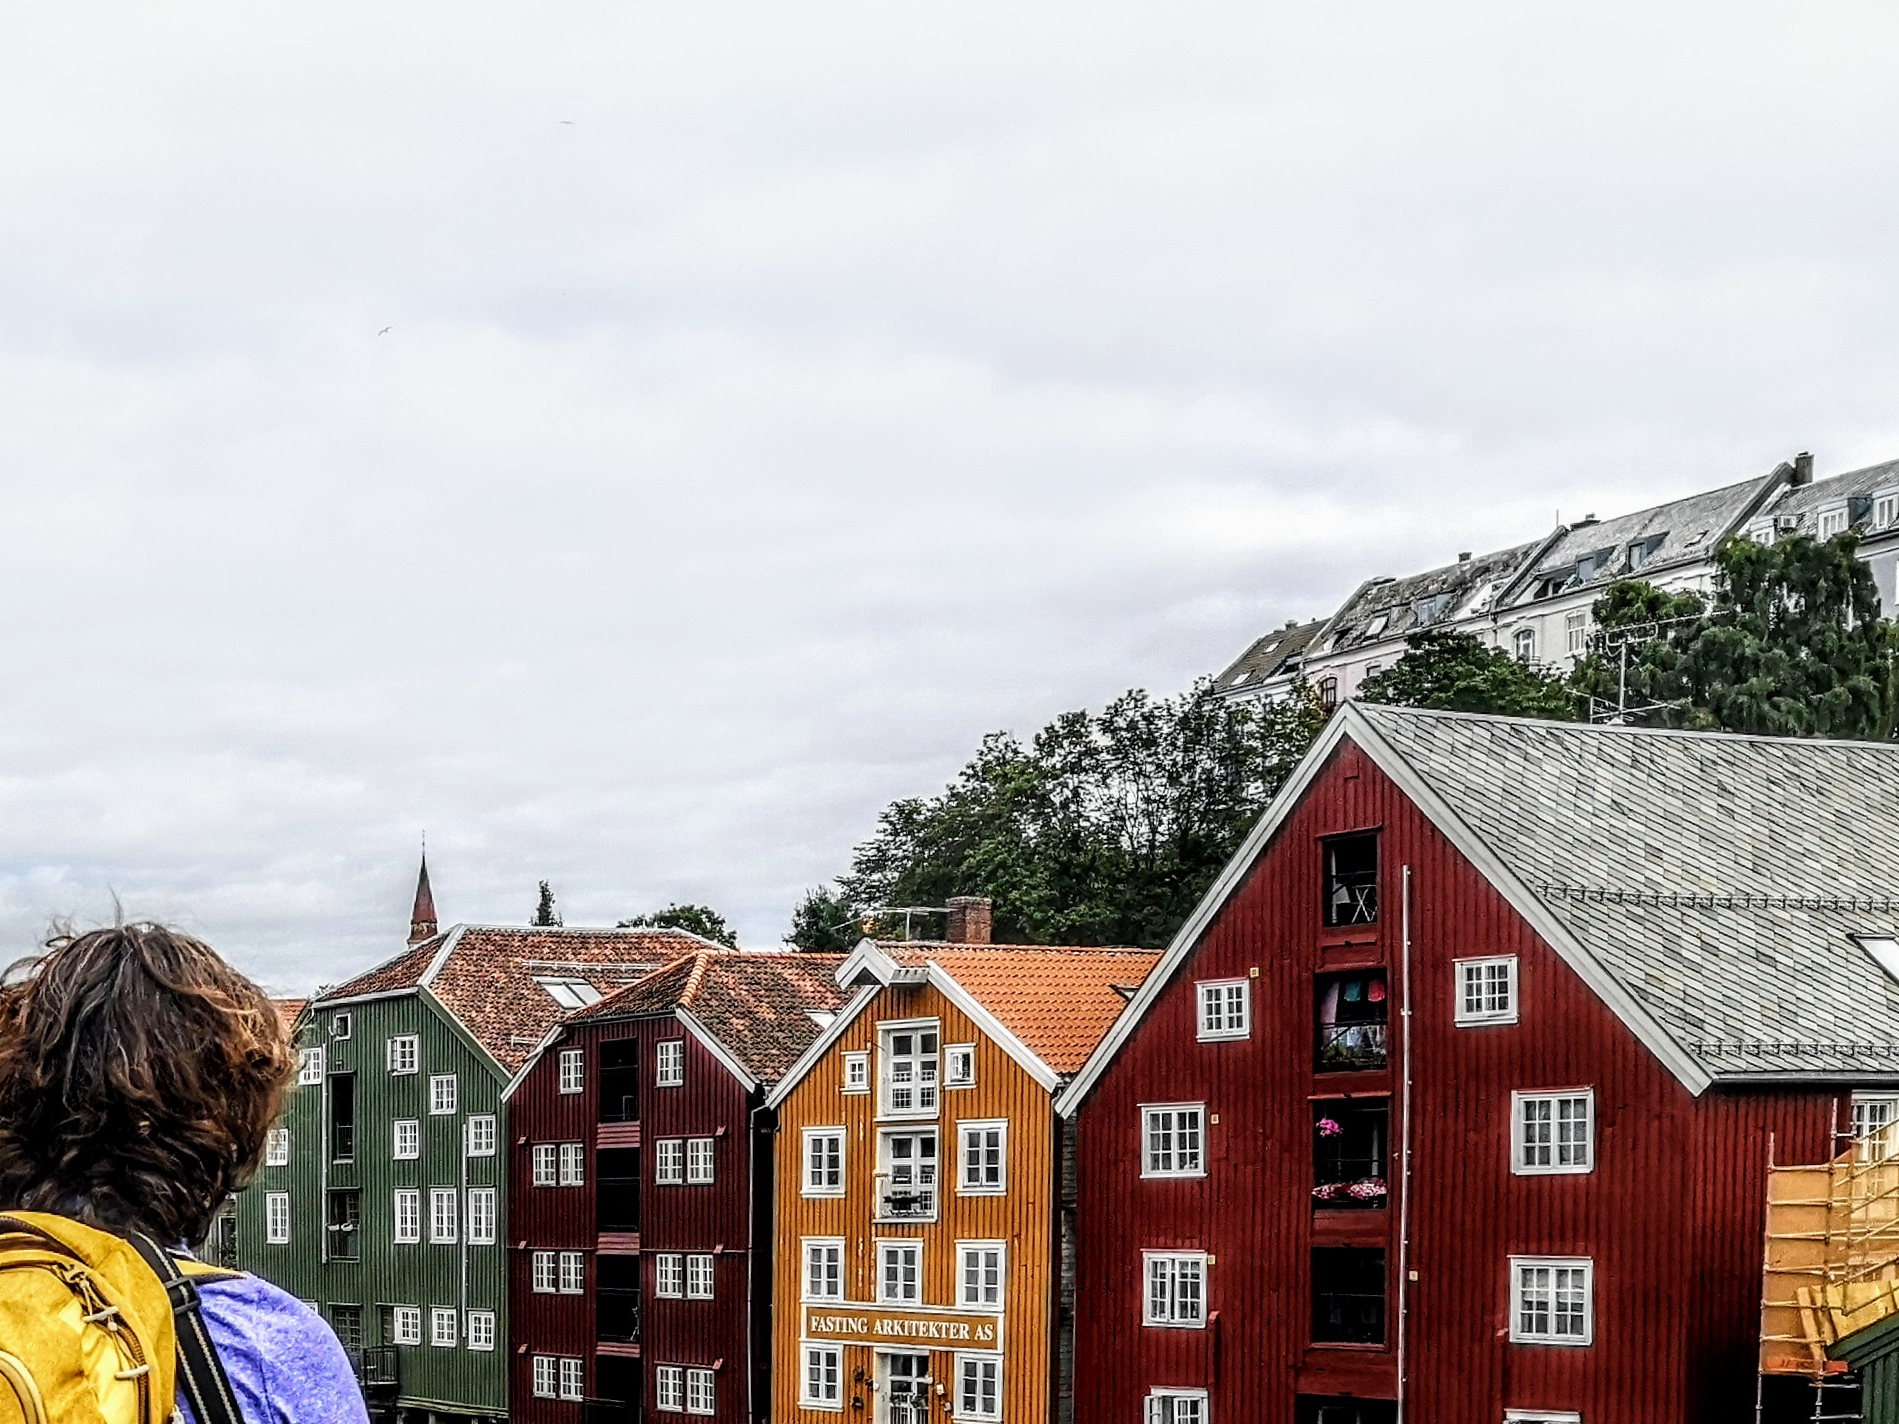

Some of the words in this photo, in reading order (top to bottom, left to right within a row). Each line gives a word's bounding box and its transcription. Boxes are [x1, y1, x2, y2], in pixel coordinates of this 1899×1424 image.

[810, 1316, 868, 1334] FASTING
[873, 1318, 970, 1340] ARKITEKTER
[974, 1324, 994, 1341] AS
